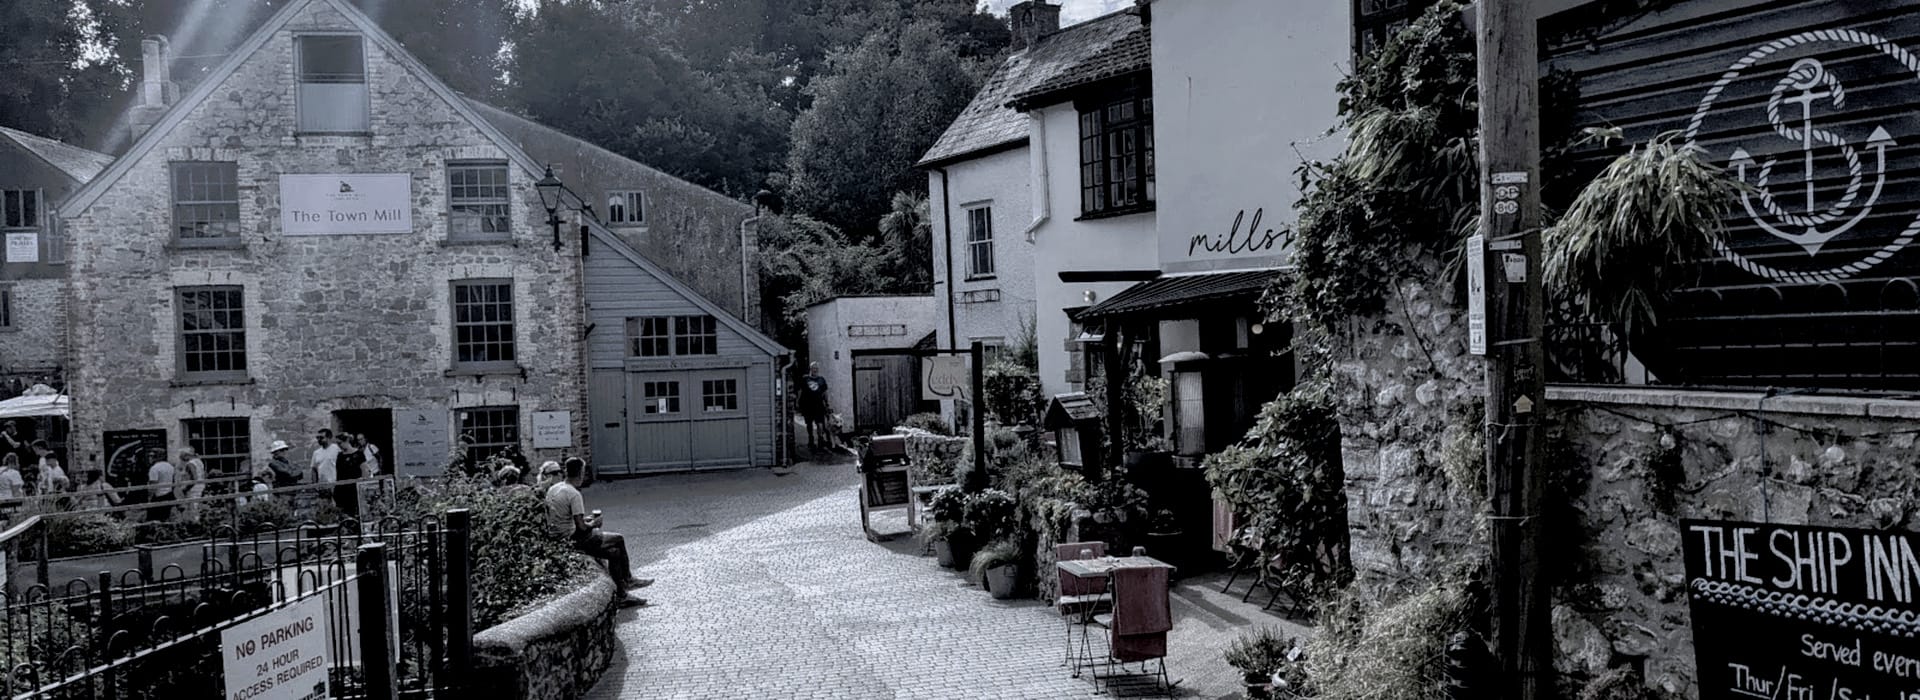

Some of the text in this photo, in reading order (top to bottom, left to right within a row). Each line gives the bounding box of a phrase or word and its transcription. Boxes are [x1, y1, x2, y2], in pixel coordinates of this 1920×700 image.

[291, 207, 401, 222] The Town Mill
[1690, 525, 1920, 603] THE SHIP INN
[235, 616, 314, 661] NO PARKING
[1801, 633, 1920, 679] Served ever
[233, 655, 323, 700] ACCESS REQUIRED
[256, 648, 300, 677] 24 HOUR
